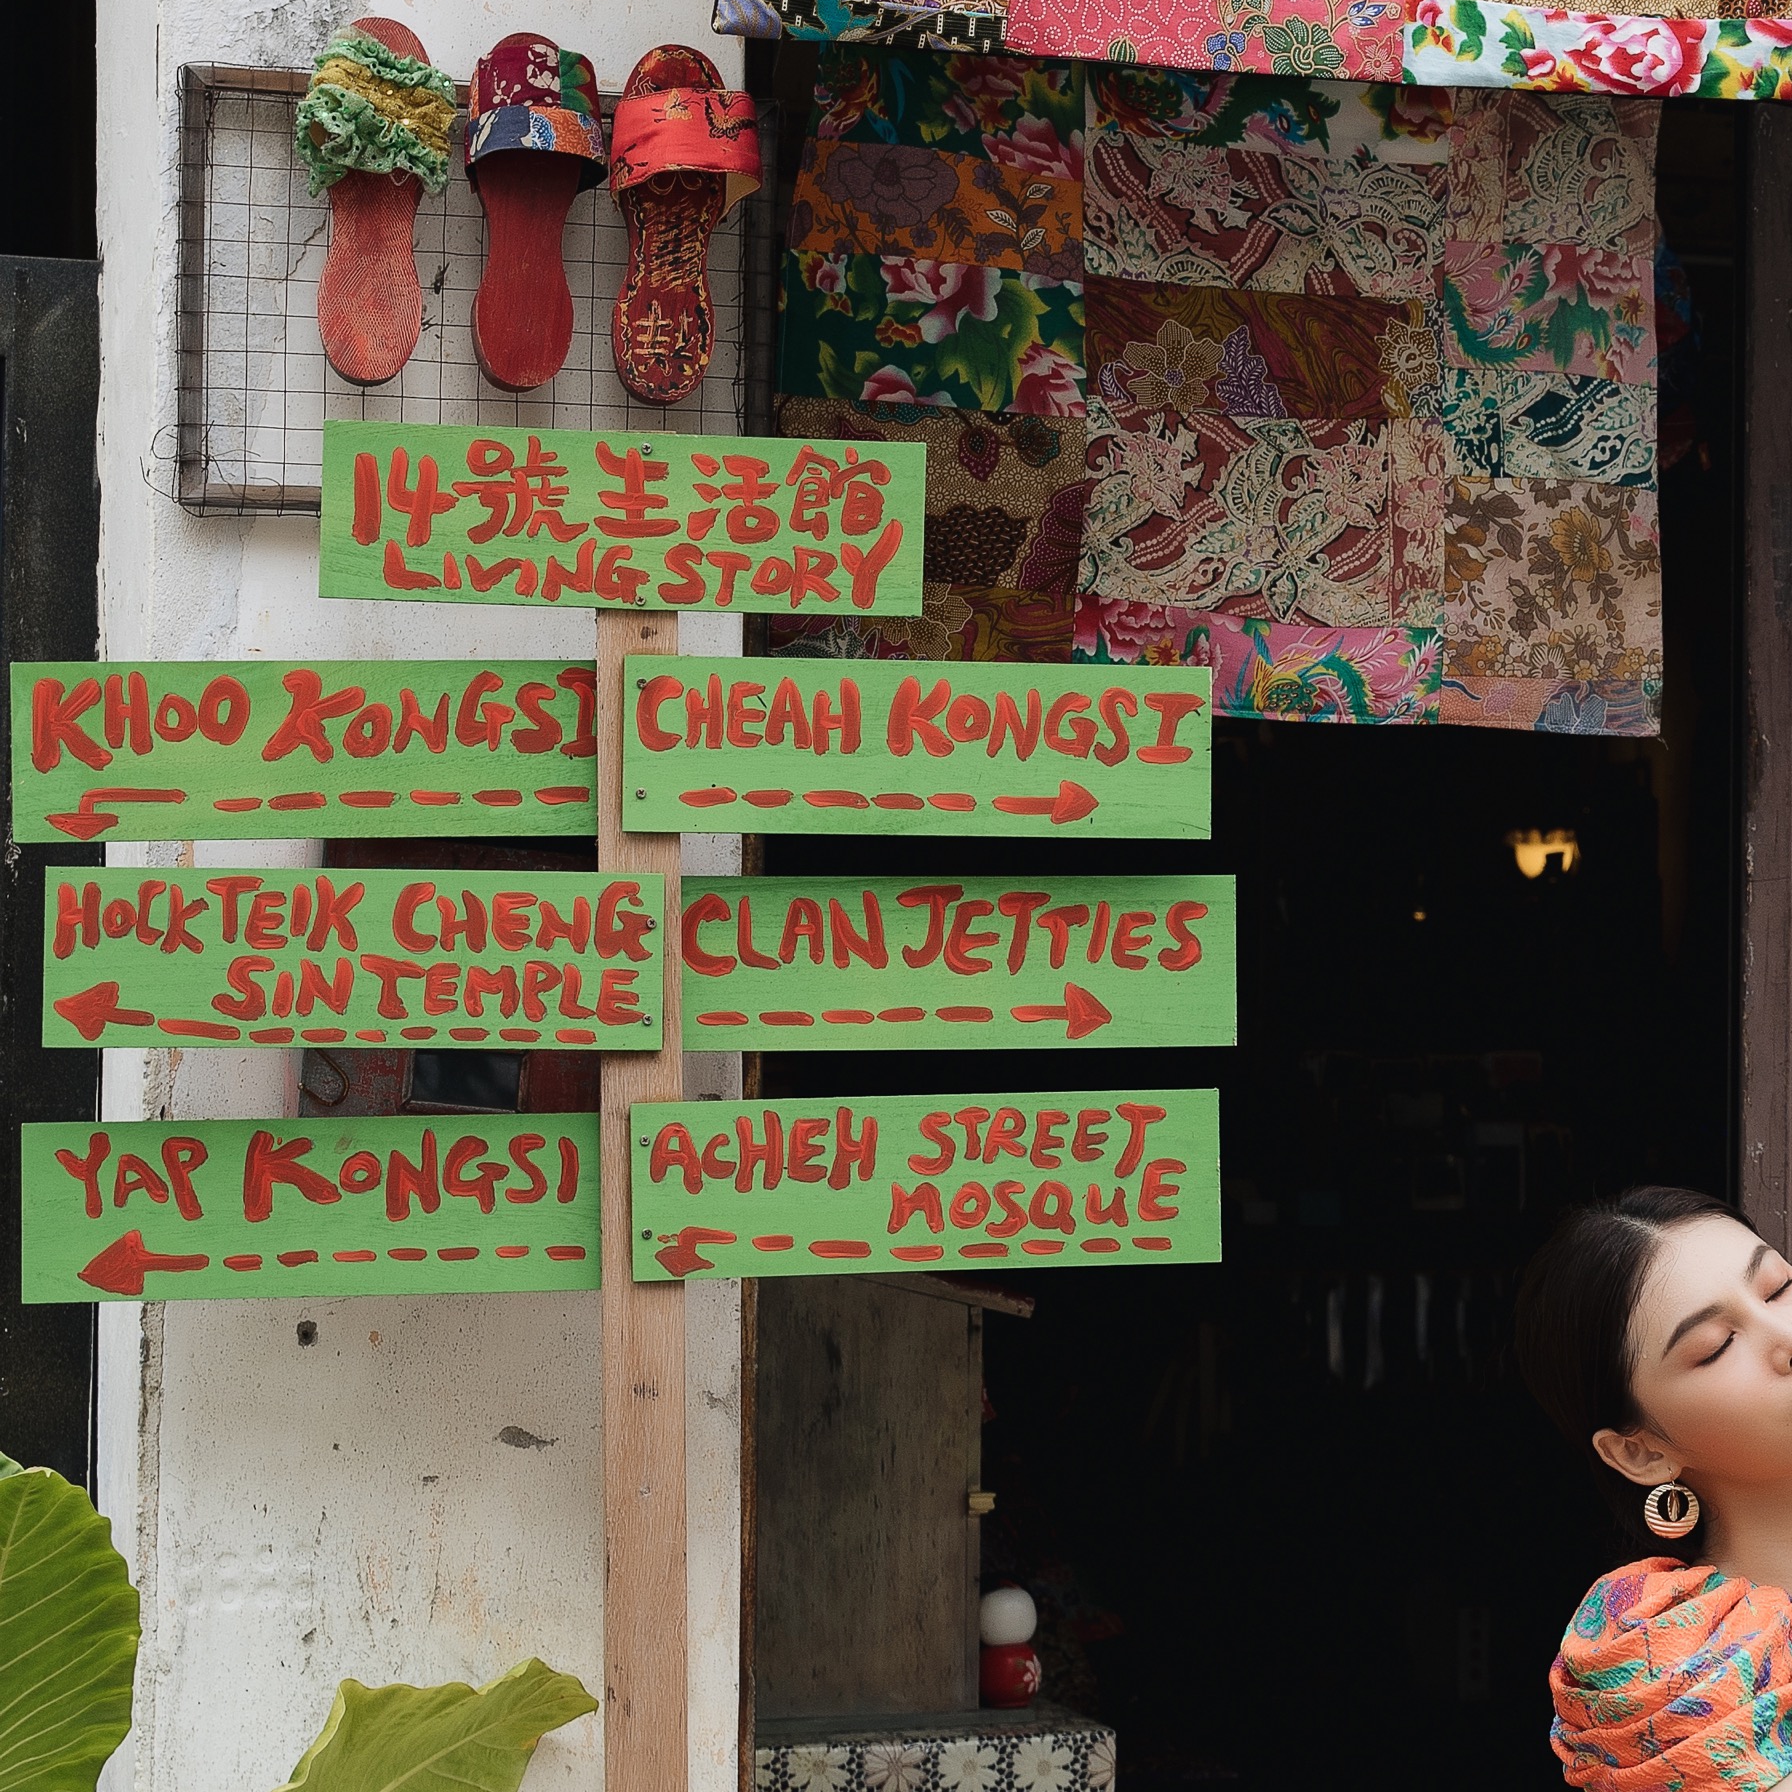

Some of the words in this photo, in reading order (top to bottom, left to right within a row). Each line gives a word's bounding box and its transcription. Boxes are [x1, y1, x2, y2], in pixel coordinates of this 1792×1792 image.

[351, 434, 892, 547] 14號生活館
[382, 539, 651, 604] LIVING
[658, 518, 903, 609] STORY
[32, 673, 251, 772] KHOO
[262, 668, 598, 763] KONGSI
[636, 674, 861, 757] CHEAH
[886, 676, 1205, 765] KONGSI
[206, 875, 365, 951] TEIK
[392, 881, 654, 962] CHENG
[681, 892, 889, 977] CLAN
[897, 885, 1208, 975] JETTIES
[360, 953, 646, 1026] TEMPLE
[55, 1132, 208, 1221] YAP
[243, 1131, 579, 1223] KONGSI
[650, 1107, 879, 1195] ACHEH
[908, 1102, 1167, 1178] STREET
[887, 1158, 1187, 1238] MOSQUE
